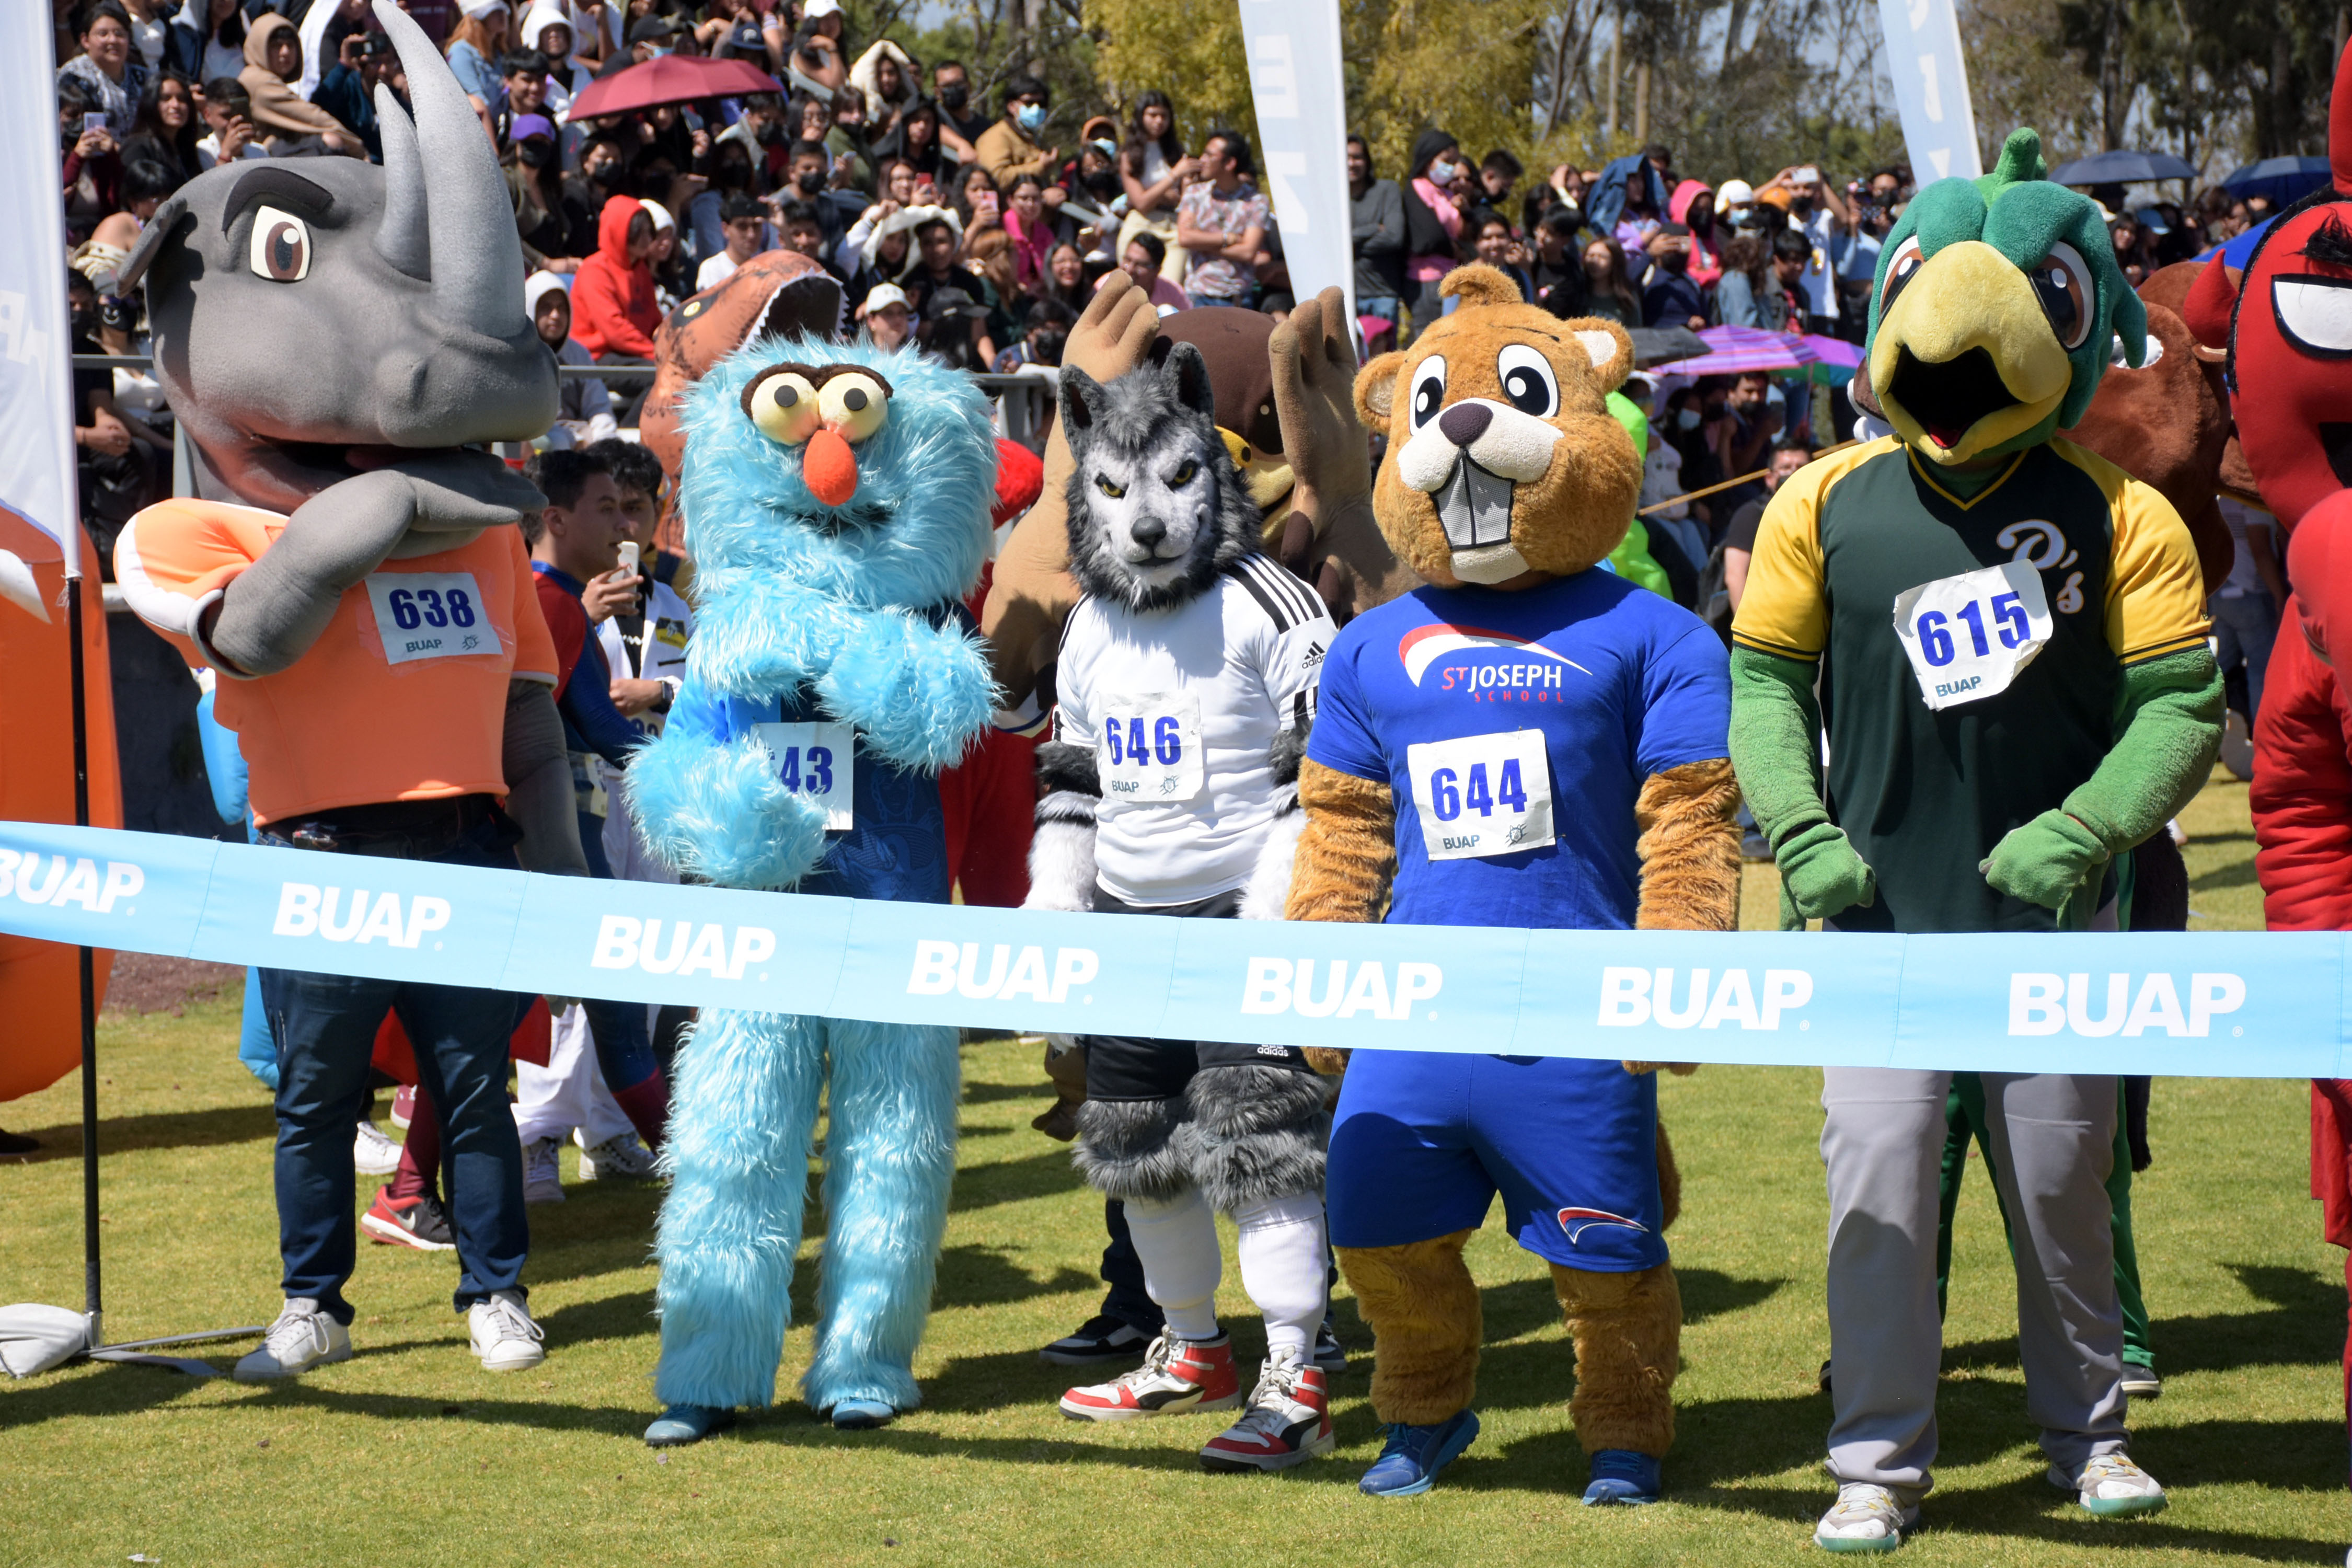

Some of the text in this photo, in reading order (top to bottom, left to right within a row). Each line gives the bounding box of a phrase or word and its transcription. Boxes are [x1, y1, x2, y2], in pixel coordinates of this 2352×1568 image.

[389, 589, 475, 629] 638
[1917, 591, 2031, 667] 615
[406, 639, 442, 653] BUAP
[1302, 654, 1325, 669] adid
[1467, 665, 1562, 693] JOSEPH
[1474, 690, 1563, 703] SCHOOL
[1935, 675, 1981, 697] BUAP
[1106, 716, 1181, 766] 646
[765, 746, 833, 794] 43
[1112, 780, 1139, 793] BUAP
[1431, 758, 1527, 822] 644
[1443, 834, 1480, 850] BUAP
[273, 882, 451, 949] BUAP
[591, 915, 776, 980] BUAP
[906, 939, 1099, 1004] BUAP
[1240, 956, 1443, 1021] BUAP
[1597, 966, 1813, 1030] BUAP
[2008, 973, 2246, 1037] BUAP
[1257, 1047, 1289, 1057] adidas
